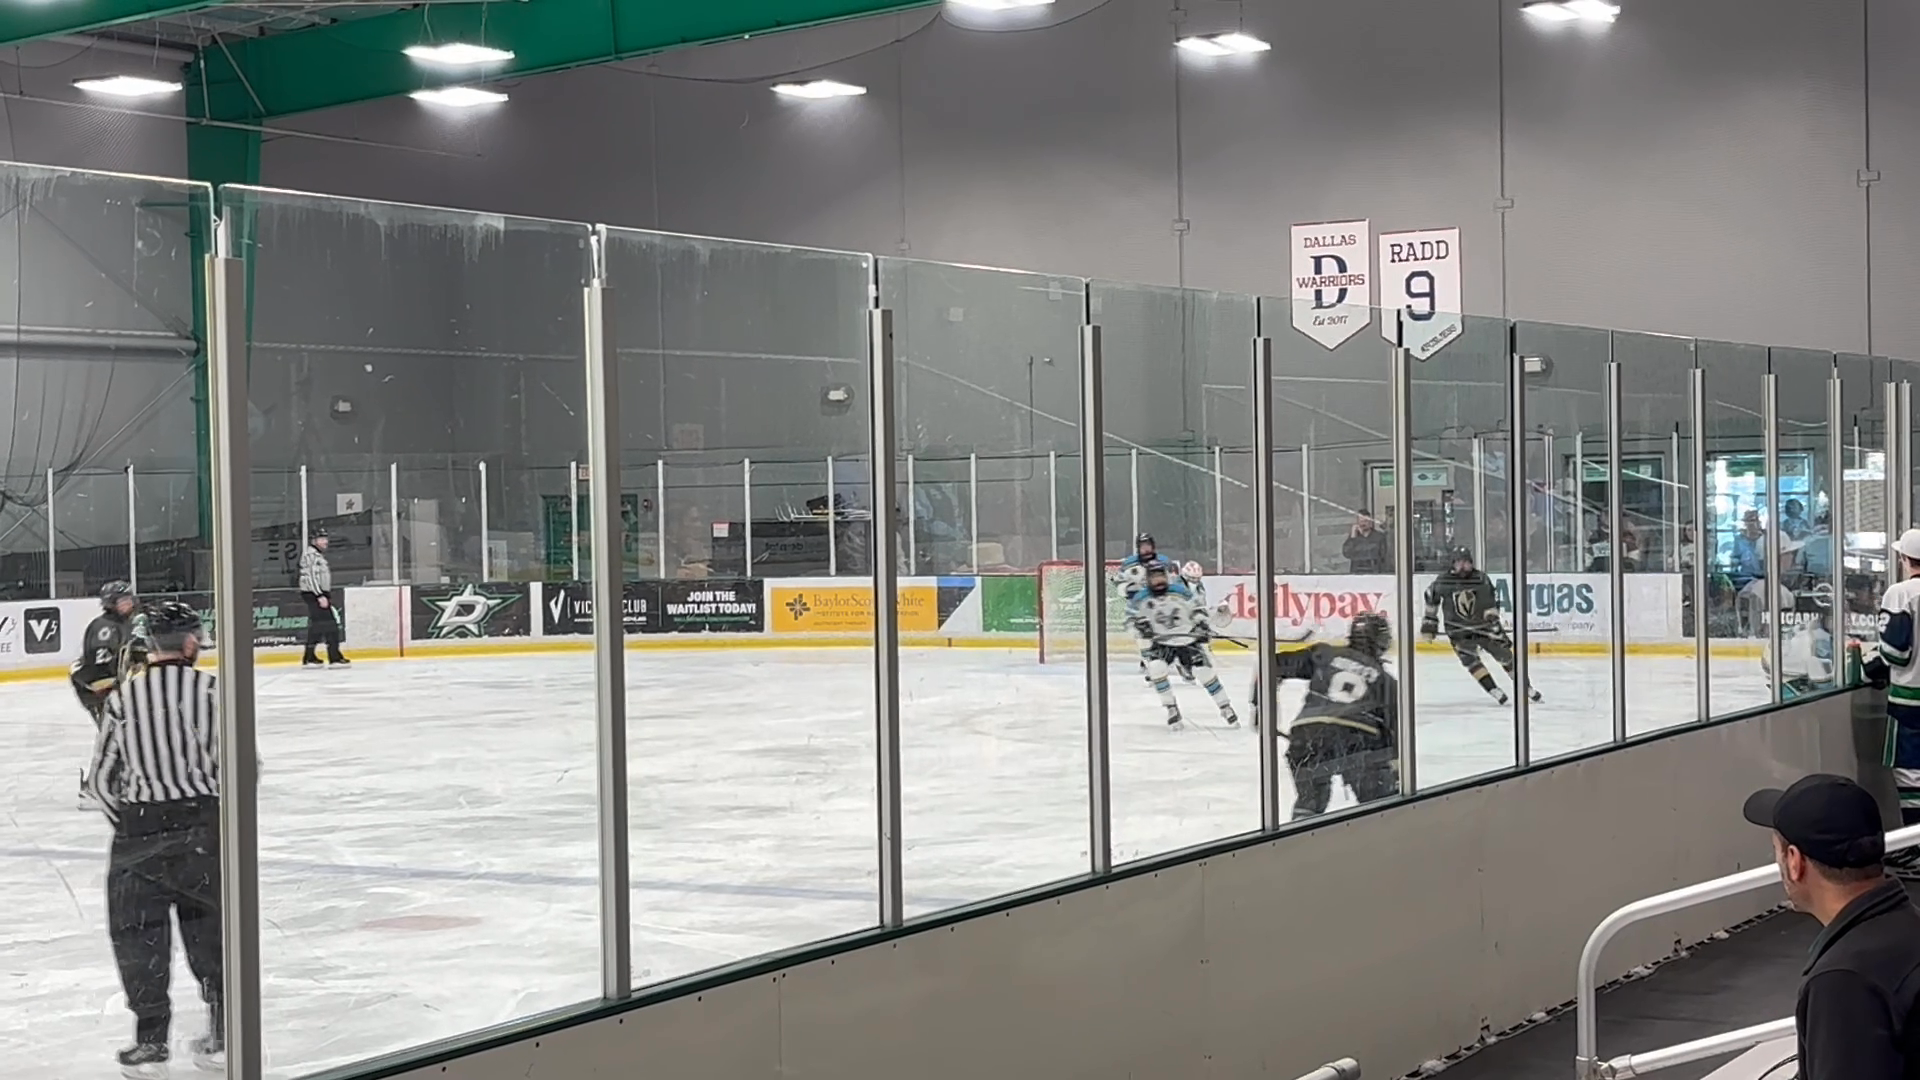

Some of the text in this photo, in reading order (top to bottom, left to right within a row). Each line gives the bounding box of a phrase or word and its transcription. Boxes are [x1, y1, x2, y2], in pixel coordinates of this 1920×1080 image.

[1303, 234, 1357, 249] DALLAS
[1389, 239, 1450, 263] RADD
[1296, 273, 1366, 289] WARRIORS
[1404, 270, 1436, 321] 9
[1326, 315, 1349, 326] 2017
[686, 590, 736, 602] JOIN THE
[1495, 579, 1595, 617] Argas
[622, 599, 647, 614] CLUB
[666, 602, 756, 615] WAITLIST TODAY!
